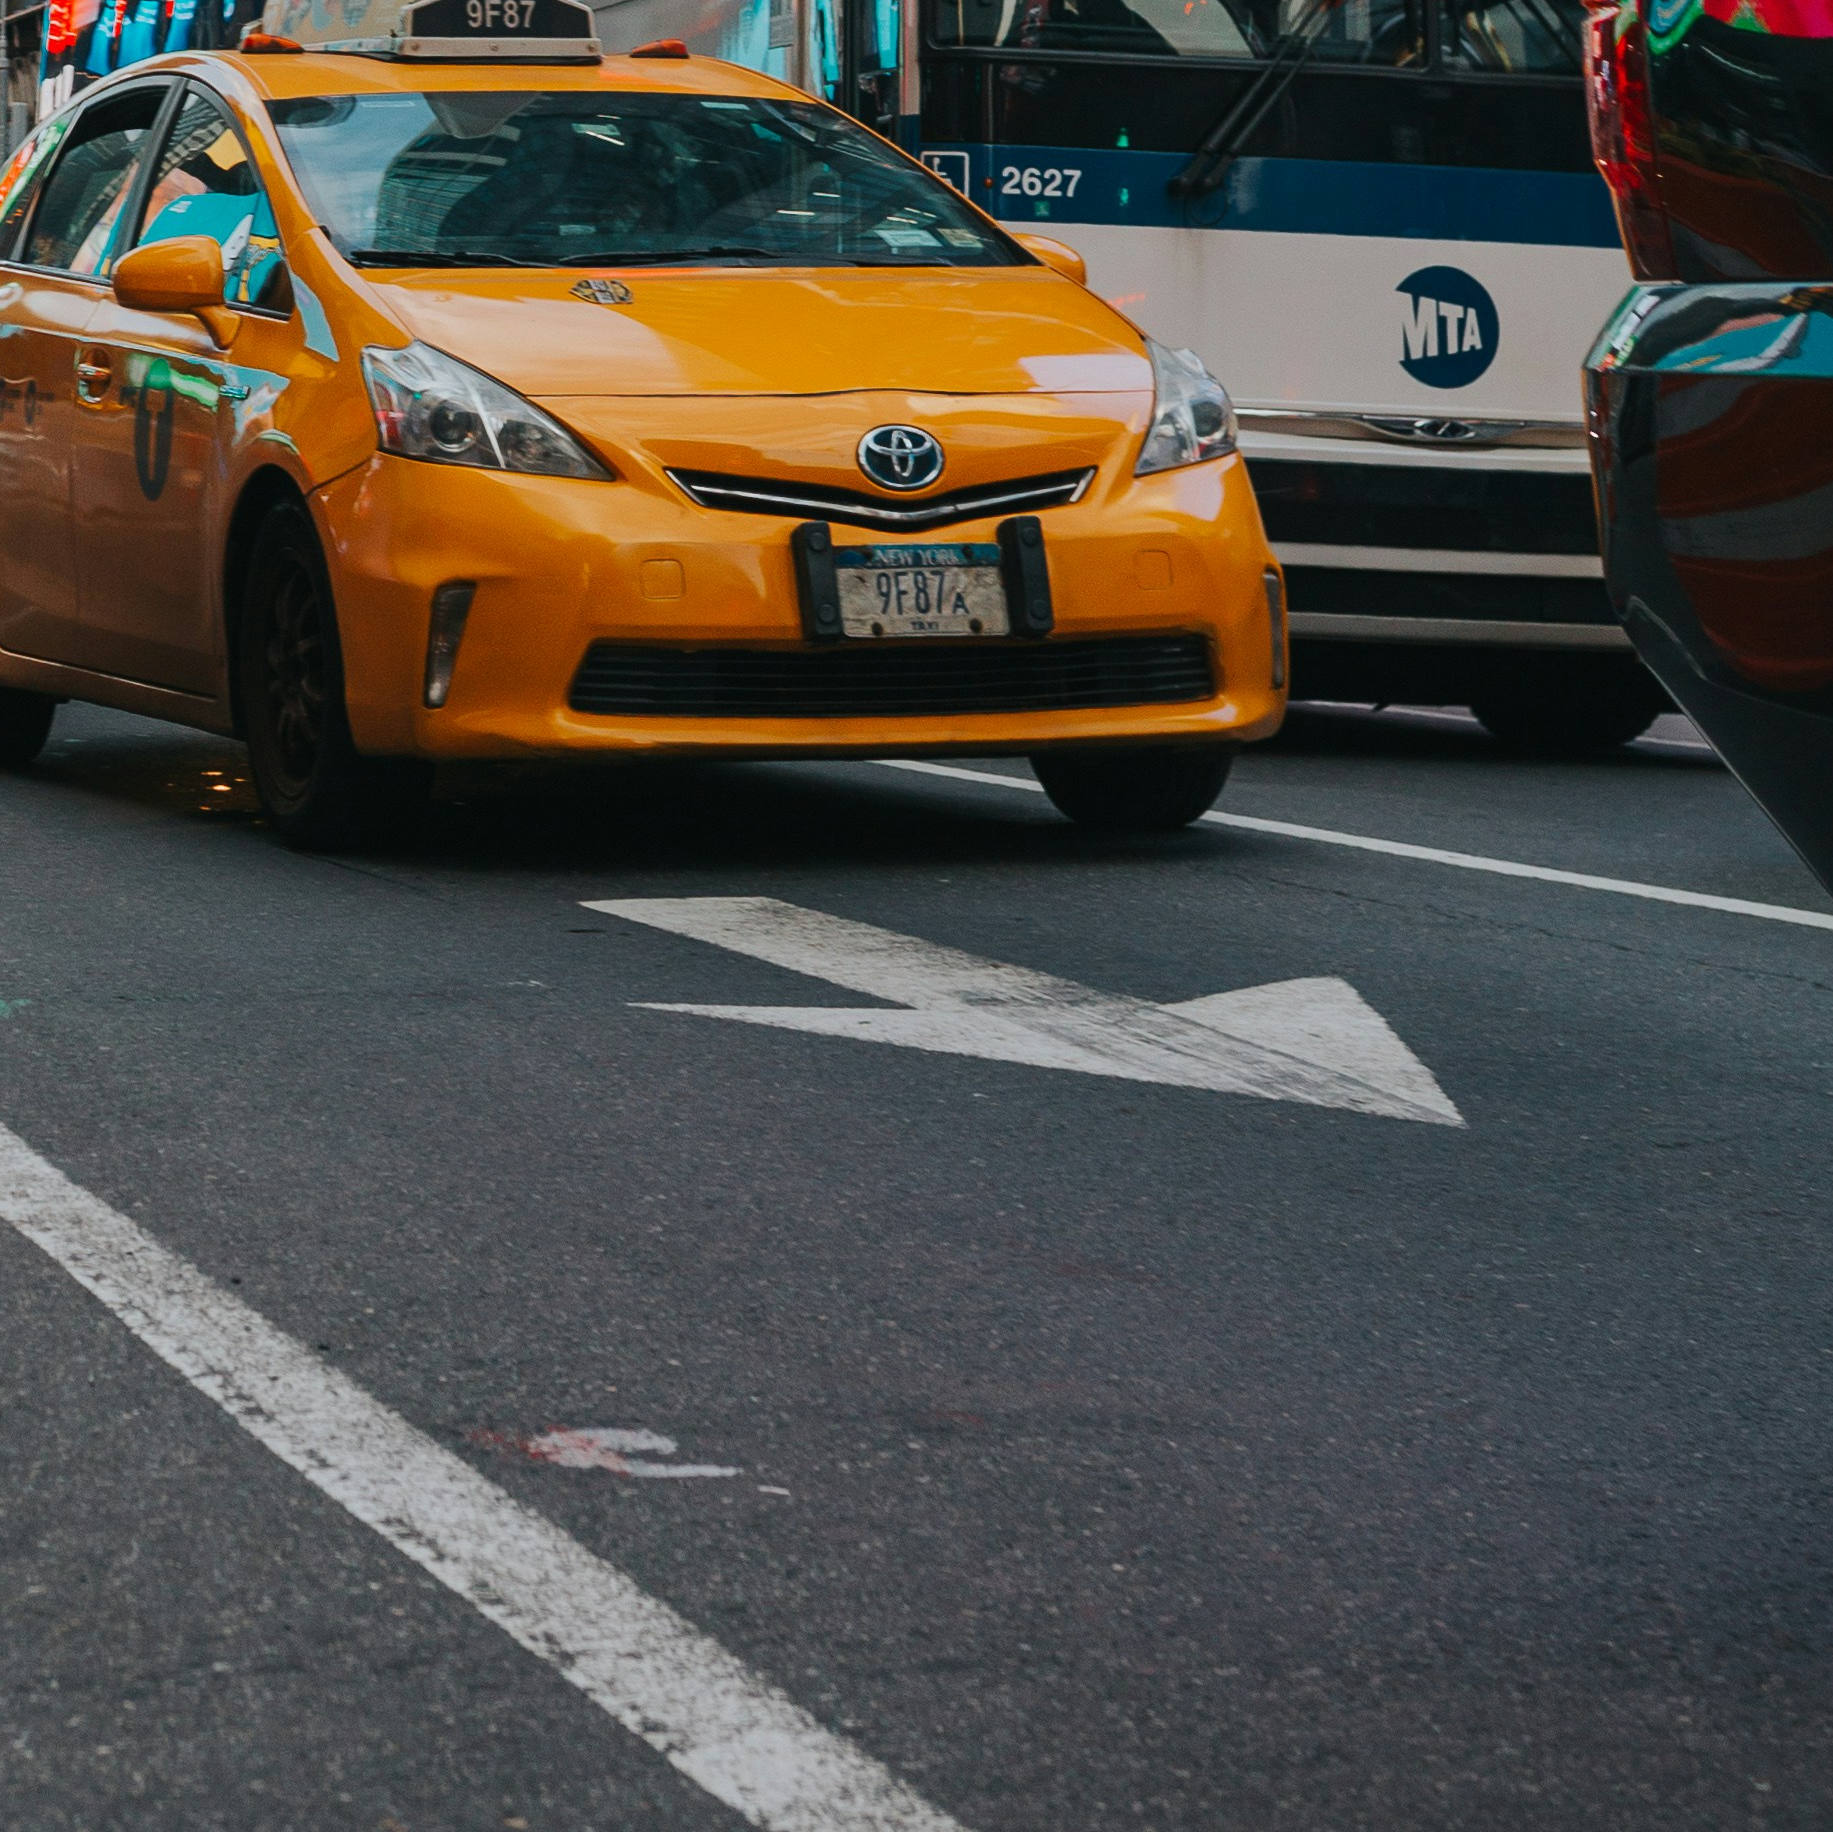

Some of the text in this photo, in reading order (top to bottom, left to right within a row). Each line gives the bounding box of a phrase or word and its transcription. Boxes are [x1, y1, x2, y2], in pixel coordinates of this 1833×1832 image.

[1001, 166, 1083, 198] 2627
[1397, 289, 1483, 362] MTA
[875, 548, 963, 566] NEW YORK
